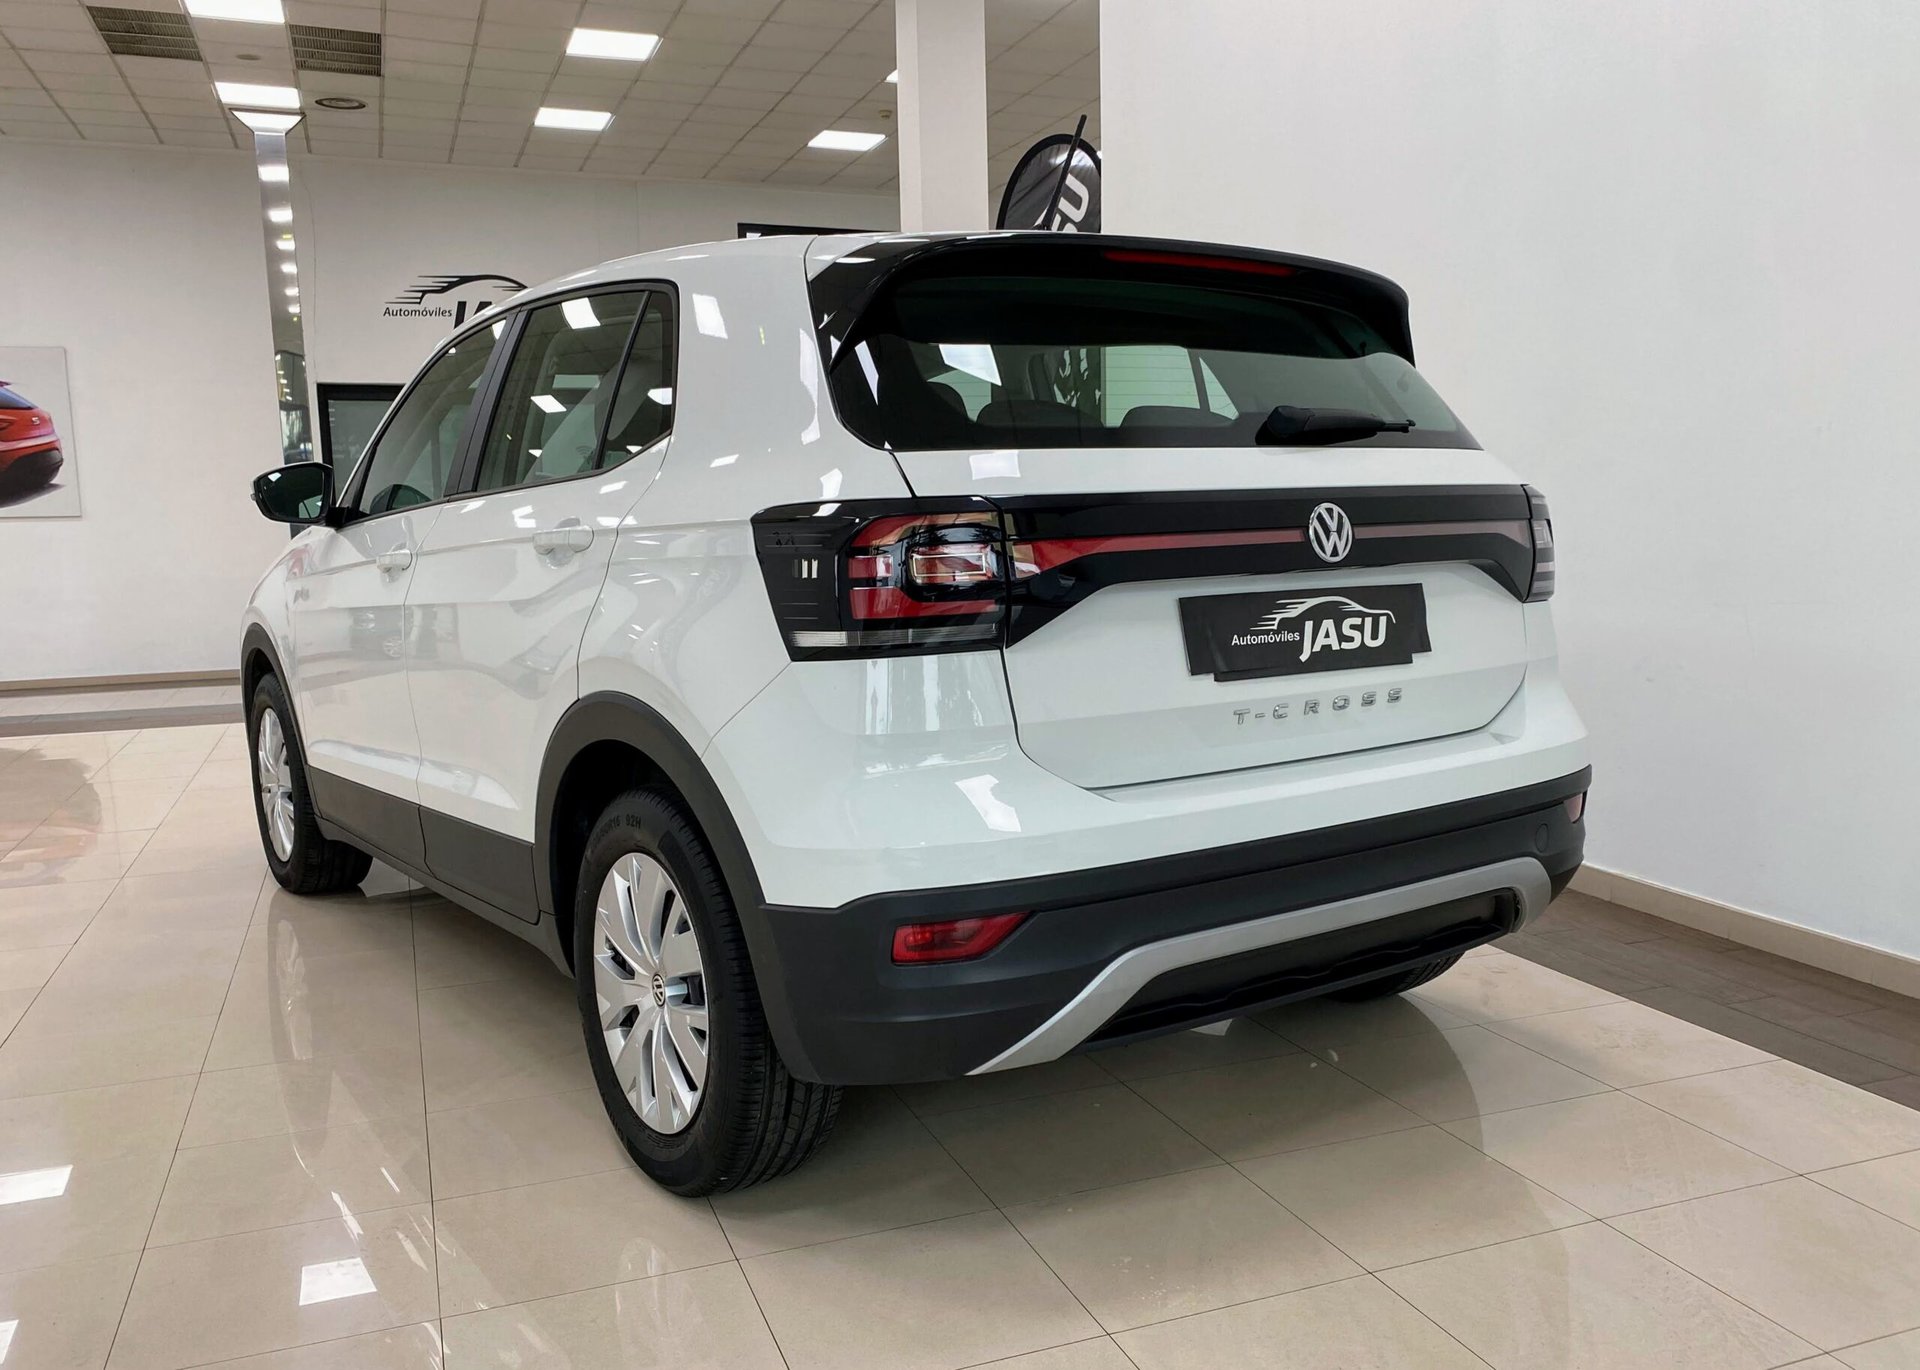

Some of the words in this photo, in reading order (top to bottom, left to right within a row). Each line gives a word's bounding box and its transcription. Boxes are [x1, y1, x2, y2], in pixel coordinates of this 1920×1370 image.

[383, 306, 453, 318] Automóviles
[1309, 502, 1353, 563] VW
[1231, 631, 1300, 646] Automóviles
[1299, 616, 1388, 663] JASU
[1233, 688, 1402, 725] T-CROSS
